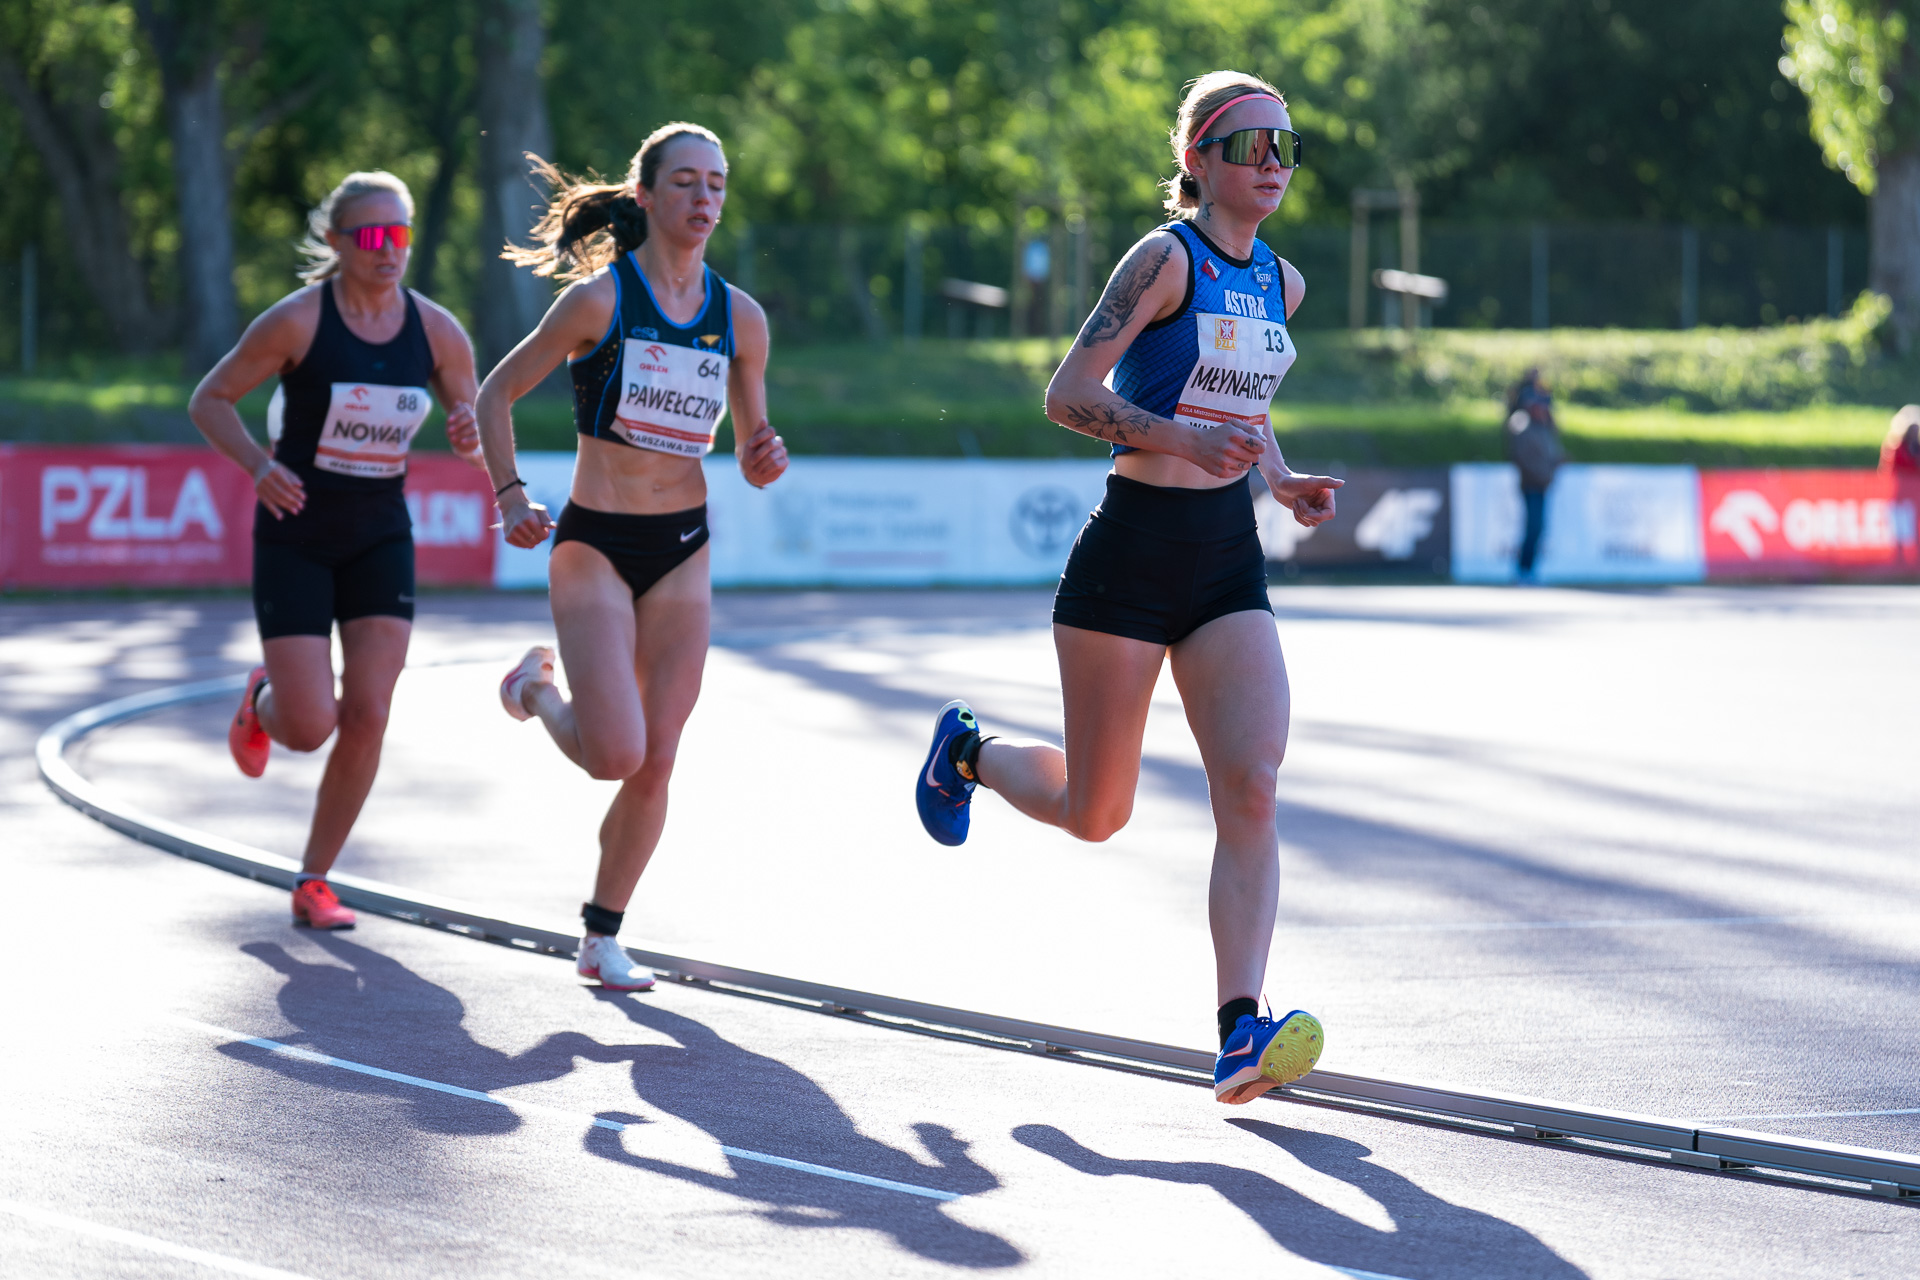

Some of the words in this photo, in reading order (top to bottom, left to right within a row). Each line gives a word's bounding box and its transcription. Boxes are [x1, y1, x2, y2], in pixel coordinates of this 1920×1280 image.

[1224, 289, 1268, 319] ASTRA
[1264, 328, 1285, 353] 13
[639, 363, 668, 374] ORLEN
[698, 358, 720, 380] 64
[397, 393, 417, 412] 88
[626, 382, 722, 420] PAWEŁCZYK
[626, 430, 683, 452] WARSZAWA
[42, 465, 224, 539] PZLA
[1354, 487, 1443, 560] 4F
